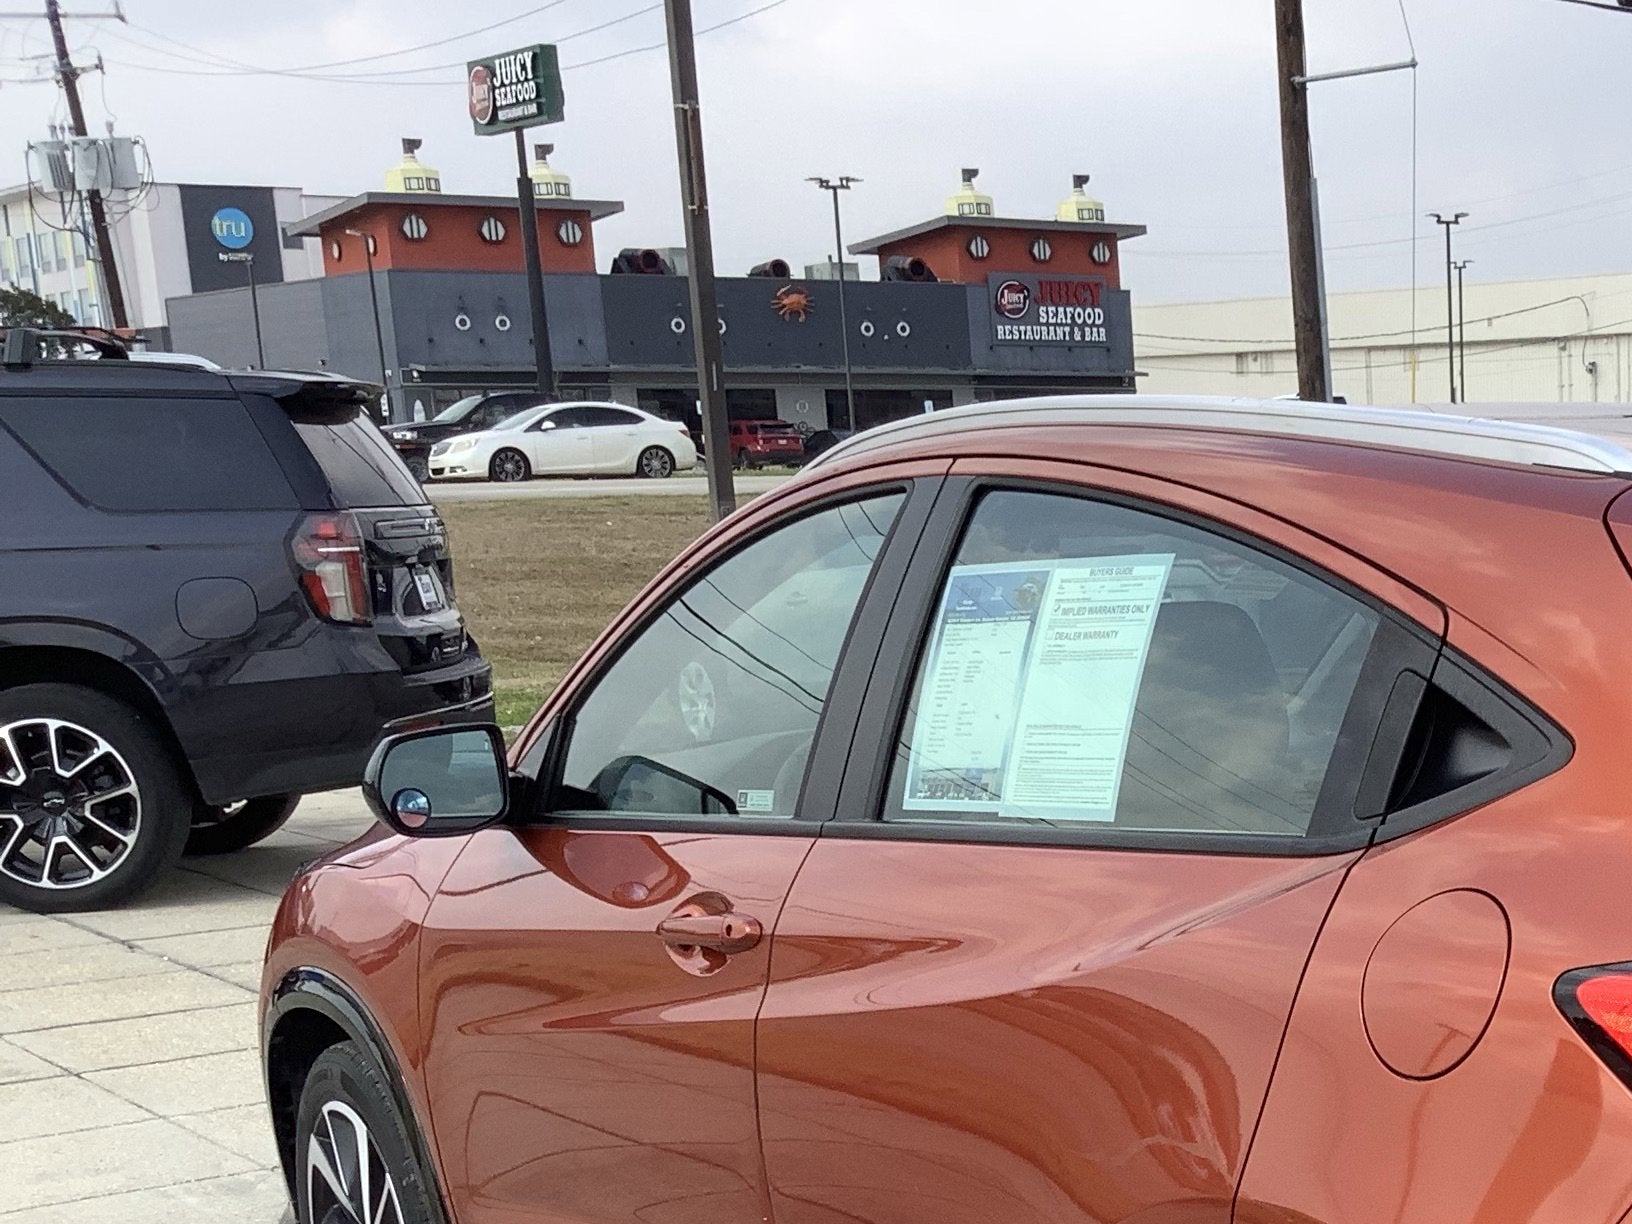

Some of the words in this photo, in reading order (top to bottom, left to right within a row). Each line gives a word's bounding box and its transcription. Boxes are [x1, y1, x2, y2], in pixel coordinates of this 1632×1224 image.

[493, 51, 533, 87] JUICY
[495, 81, 536, 107] SEAFOOD
[213, 215, 246, 237] tru
[1034, 280, 1102, 306] JUICY
[1039, 306, 1104, 324] SEAFOOD
[997, 325, 1070, 341] RESTAURANT
[1073, 327, 1081, 341] &
[1084, 327, 1106, 341] BAR
[1089, 567, 1114, 577] BUYERS
[1115, 566, 1135, 576] GUIDE
[1061, 606, 1087, 616] IMPLIED
[1088, 604, 1130, 616] WARRANTIES
[1131, 603, 1151, 614] ONLY
[1054, 631, 1082, 641] DEALER
[1083, 630, 1119, 640] WARRANTY
